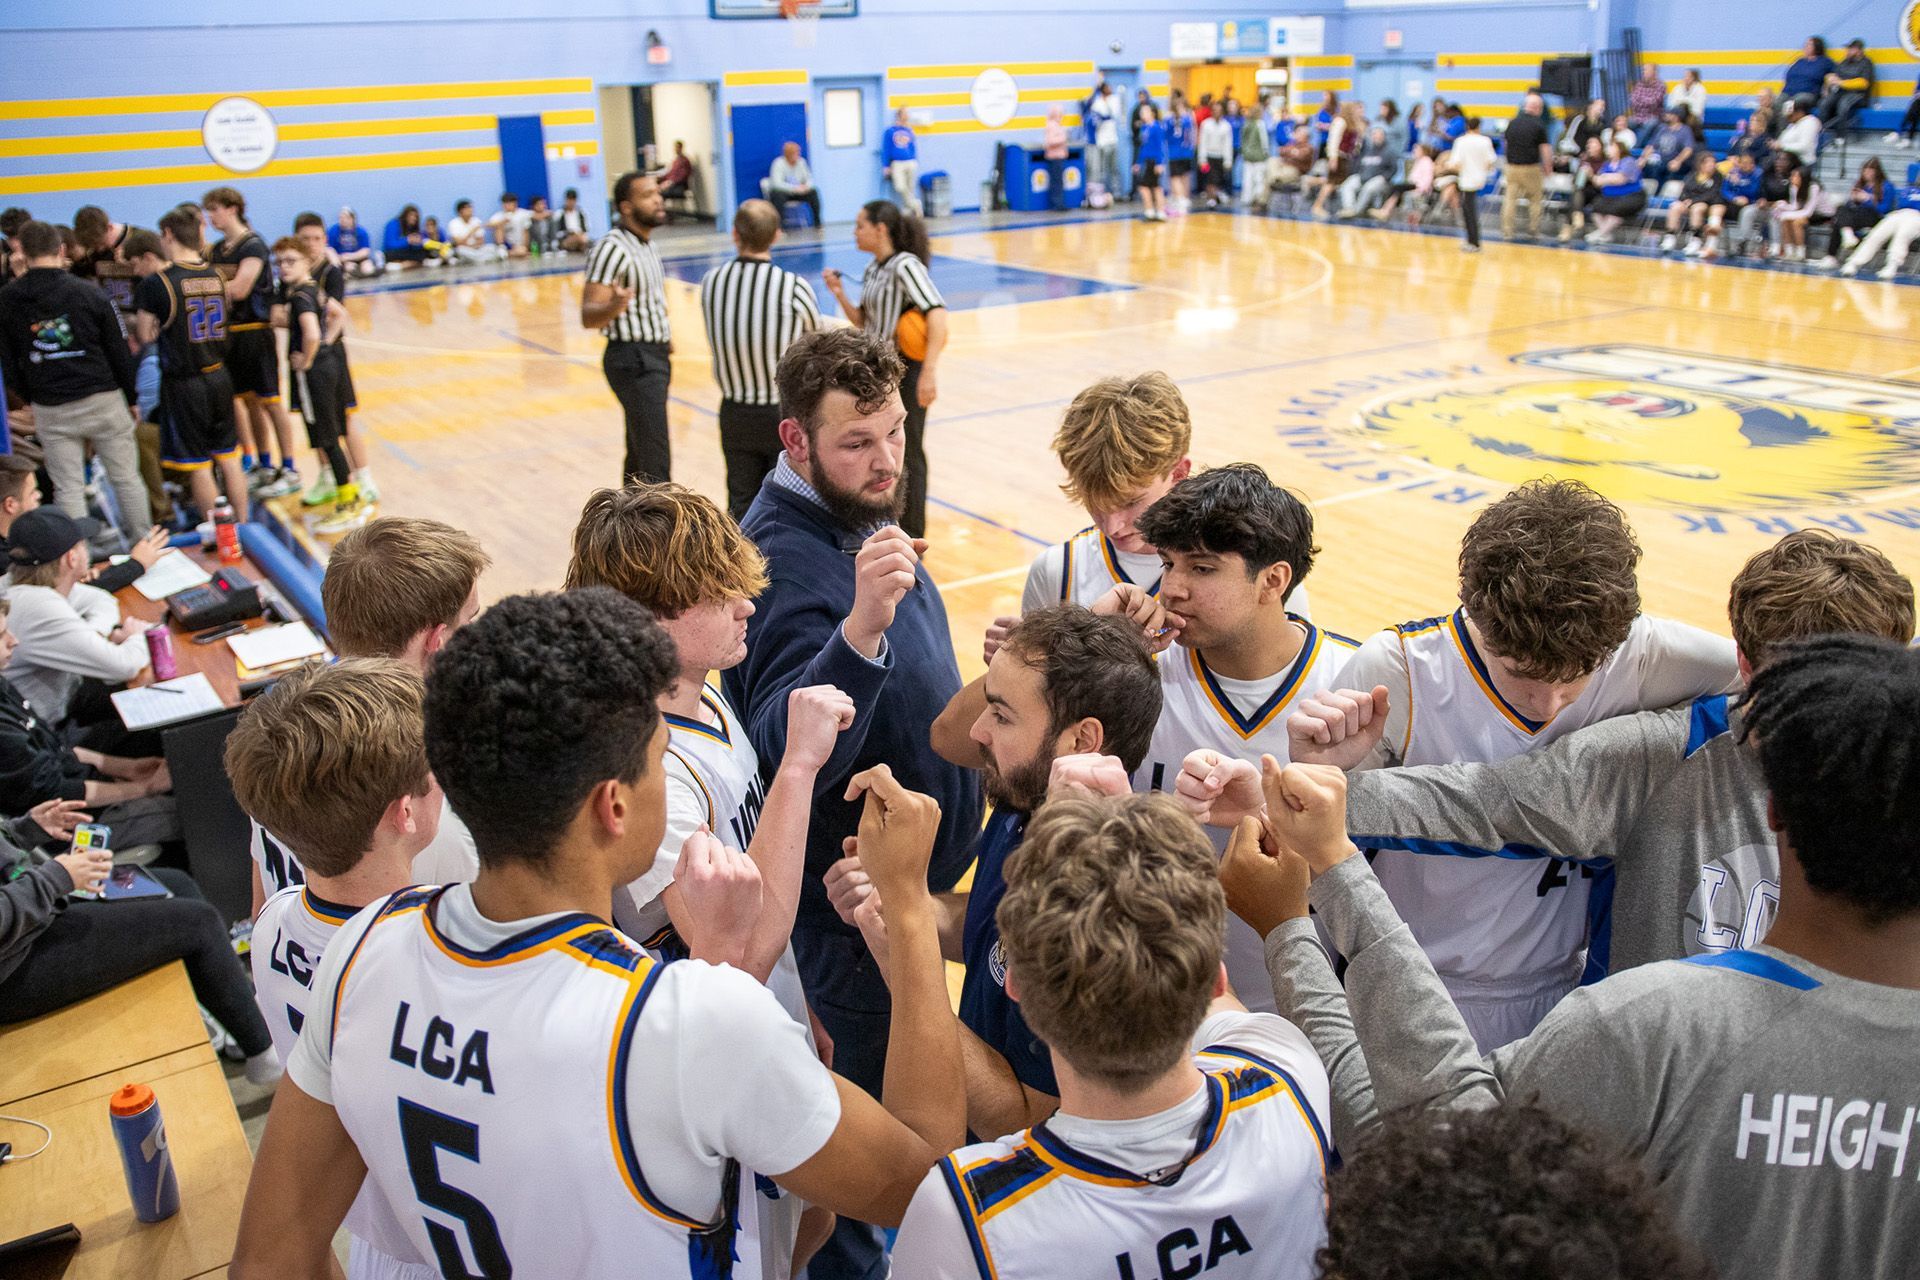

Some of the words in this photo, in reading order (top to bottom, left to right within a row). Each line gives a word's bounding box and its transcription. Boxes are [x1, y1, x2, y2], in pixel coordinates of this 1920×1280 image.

[185, 296, 228, 342] 22
[270, 926, 322, 991] LC
[389, 1000, 495, 1095] LCA
[1735, 1092, 1920, 1182] HEIGH
[397, 1095, 513, 1280] 5
